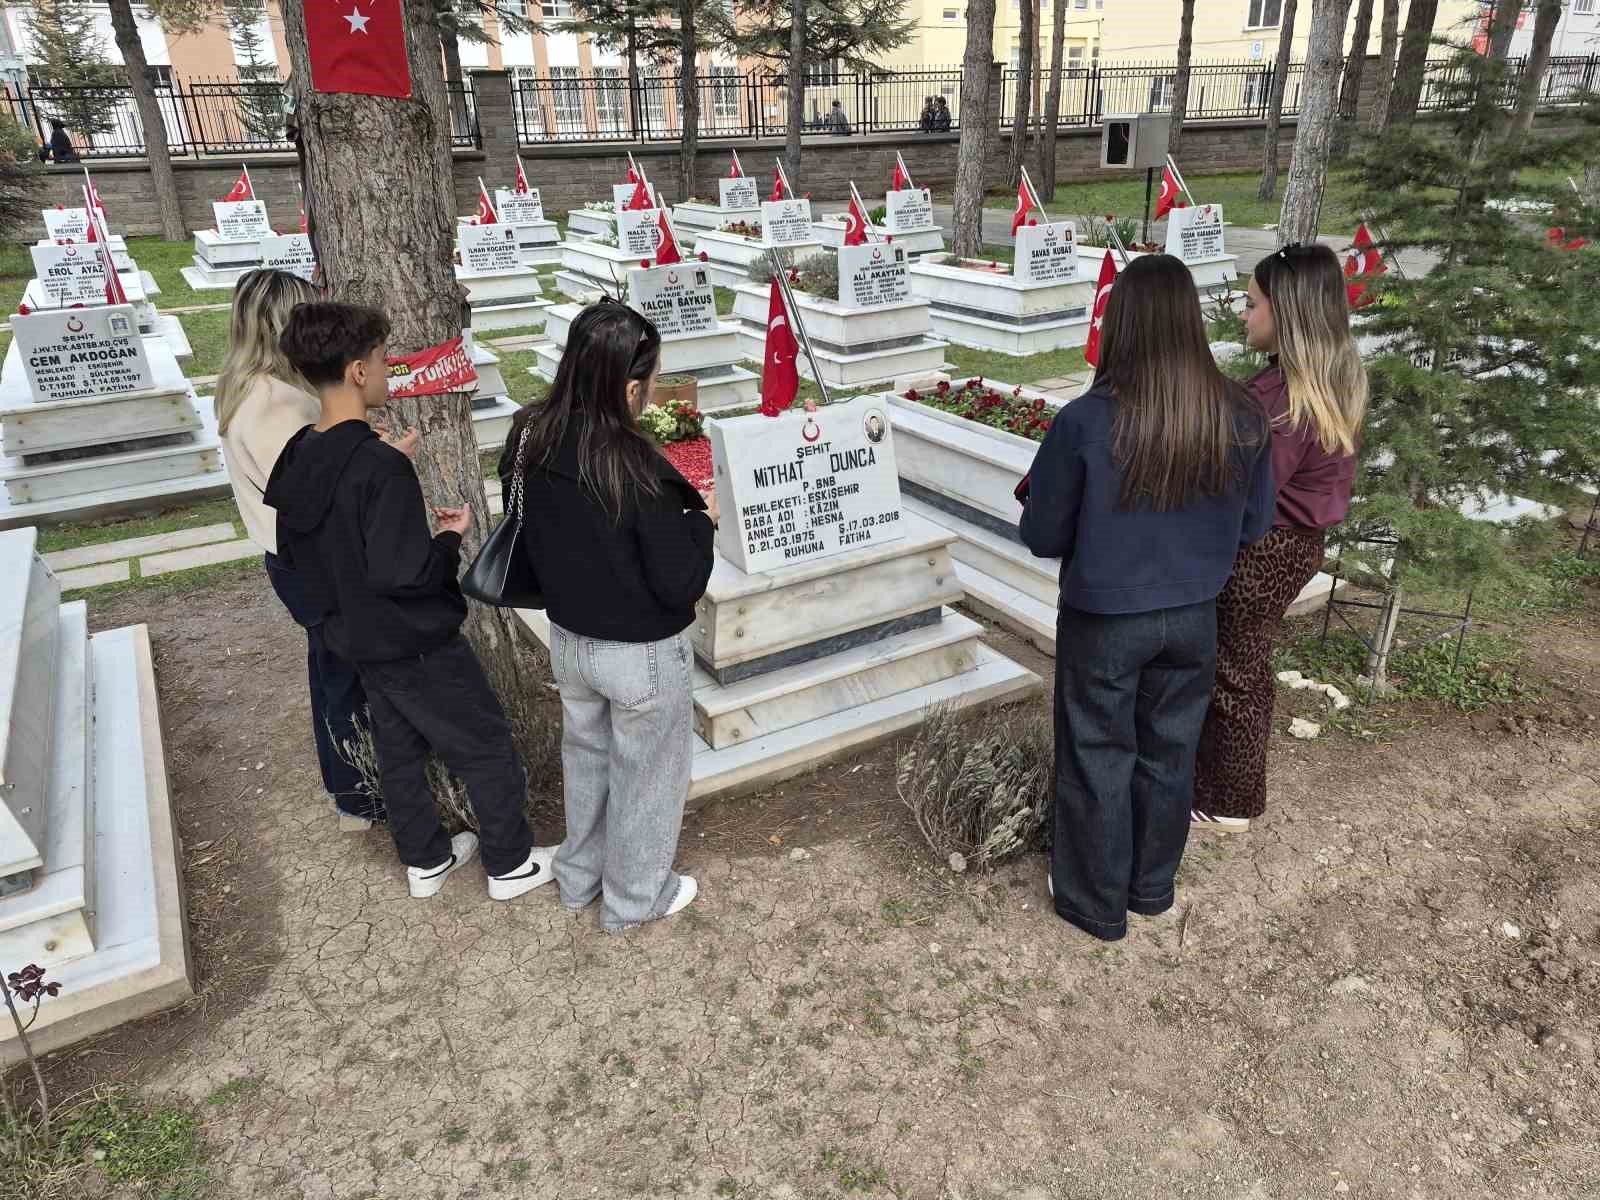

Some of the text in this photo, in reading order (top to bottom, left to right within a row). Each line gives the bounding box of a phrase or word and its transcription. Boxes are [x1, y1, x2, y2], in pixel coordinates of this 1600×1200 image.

[48, 265, 104, 277] EROL AYAZ
[29, 347, 138, 368] CEM AKDOĞAN
[50, 388, 95, 398] RUHUNA
[796, 442, 831, 459] ŞEHİT
[754, 447, 876, 488] MİTHAT DUNCA
[744, 515, 772, 530] BABA
[778, 509, 794, 523] ADI
[747, 527, 774, 542] ANNE
[779, 522, 796, 535] ADI
[784, 529, 871, 559] RUHUNA FATİHA
